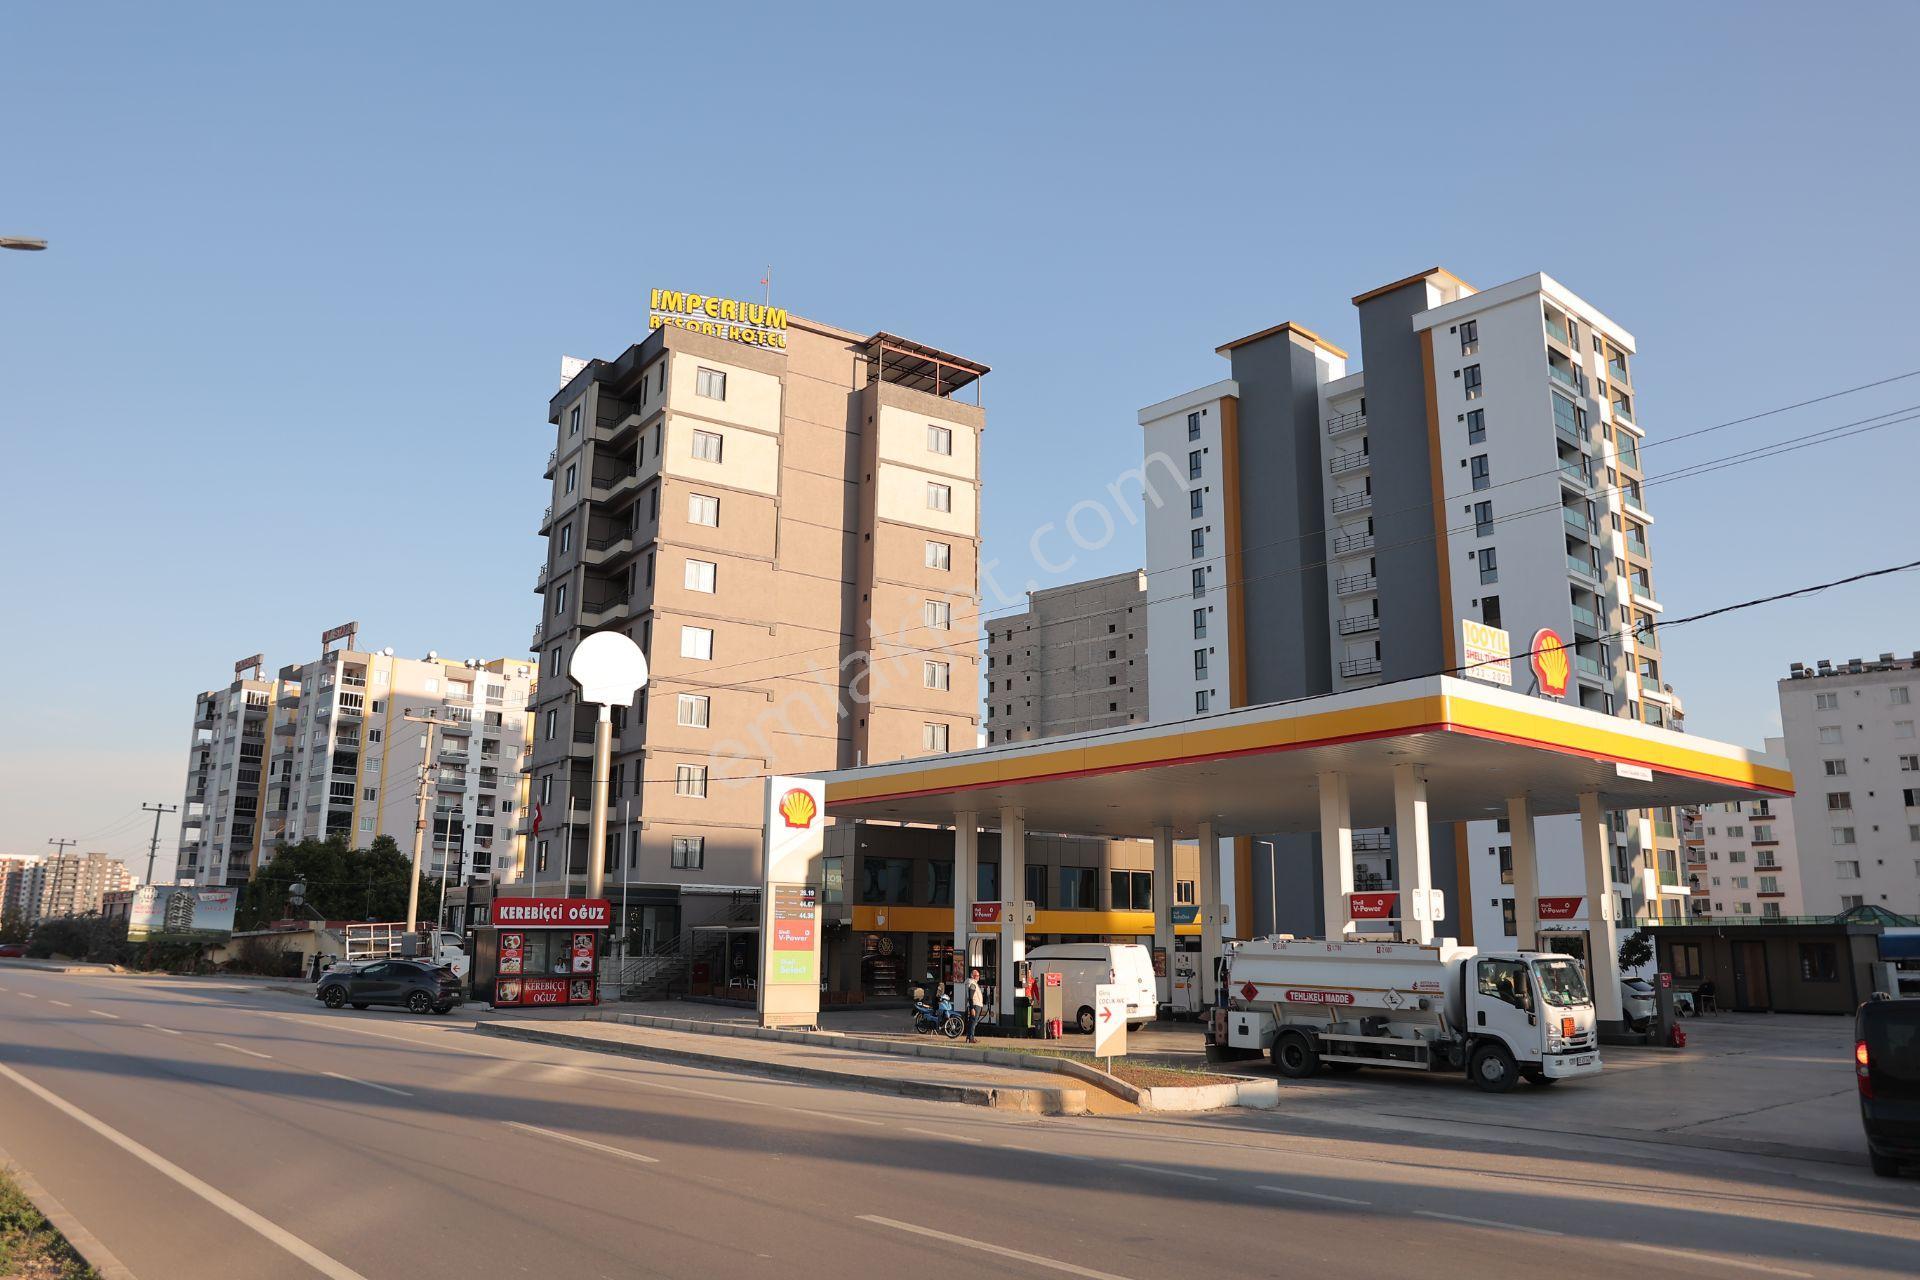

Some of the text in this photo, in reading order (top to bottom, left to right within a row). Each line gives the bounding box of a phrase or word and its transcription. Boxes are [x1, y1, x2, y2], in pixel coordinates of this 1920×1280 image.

[650, 287, 787, 330] IMPERIUM
[649, 314, 787, 348] RESORT HOTEL
[1466, 649, 1483, 662] SHELL
[569, 904, 605, 920] OĞUZ
[1008, 914, 1014, 922] 3
[1026, 914, 1032, 922] 4
[533, 993, 557, 1003] OĞUZ
[1324, 993, 1350, 1004] MADDE
